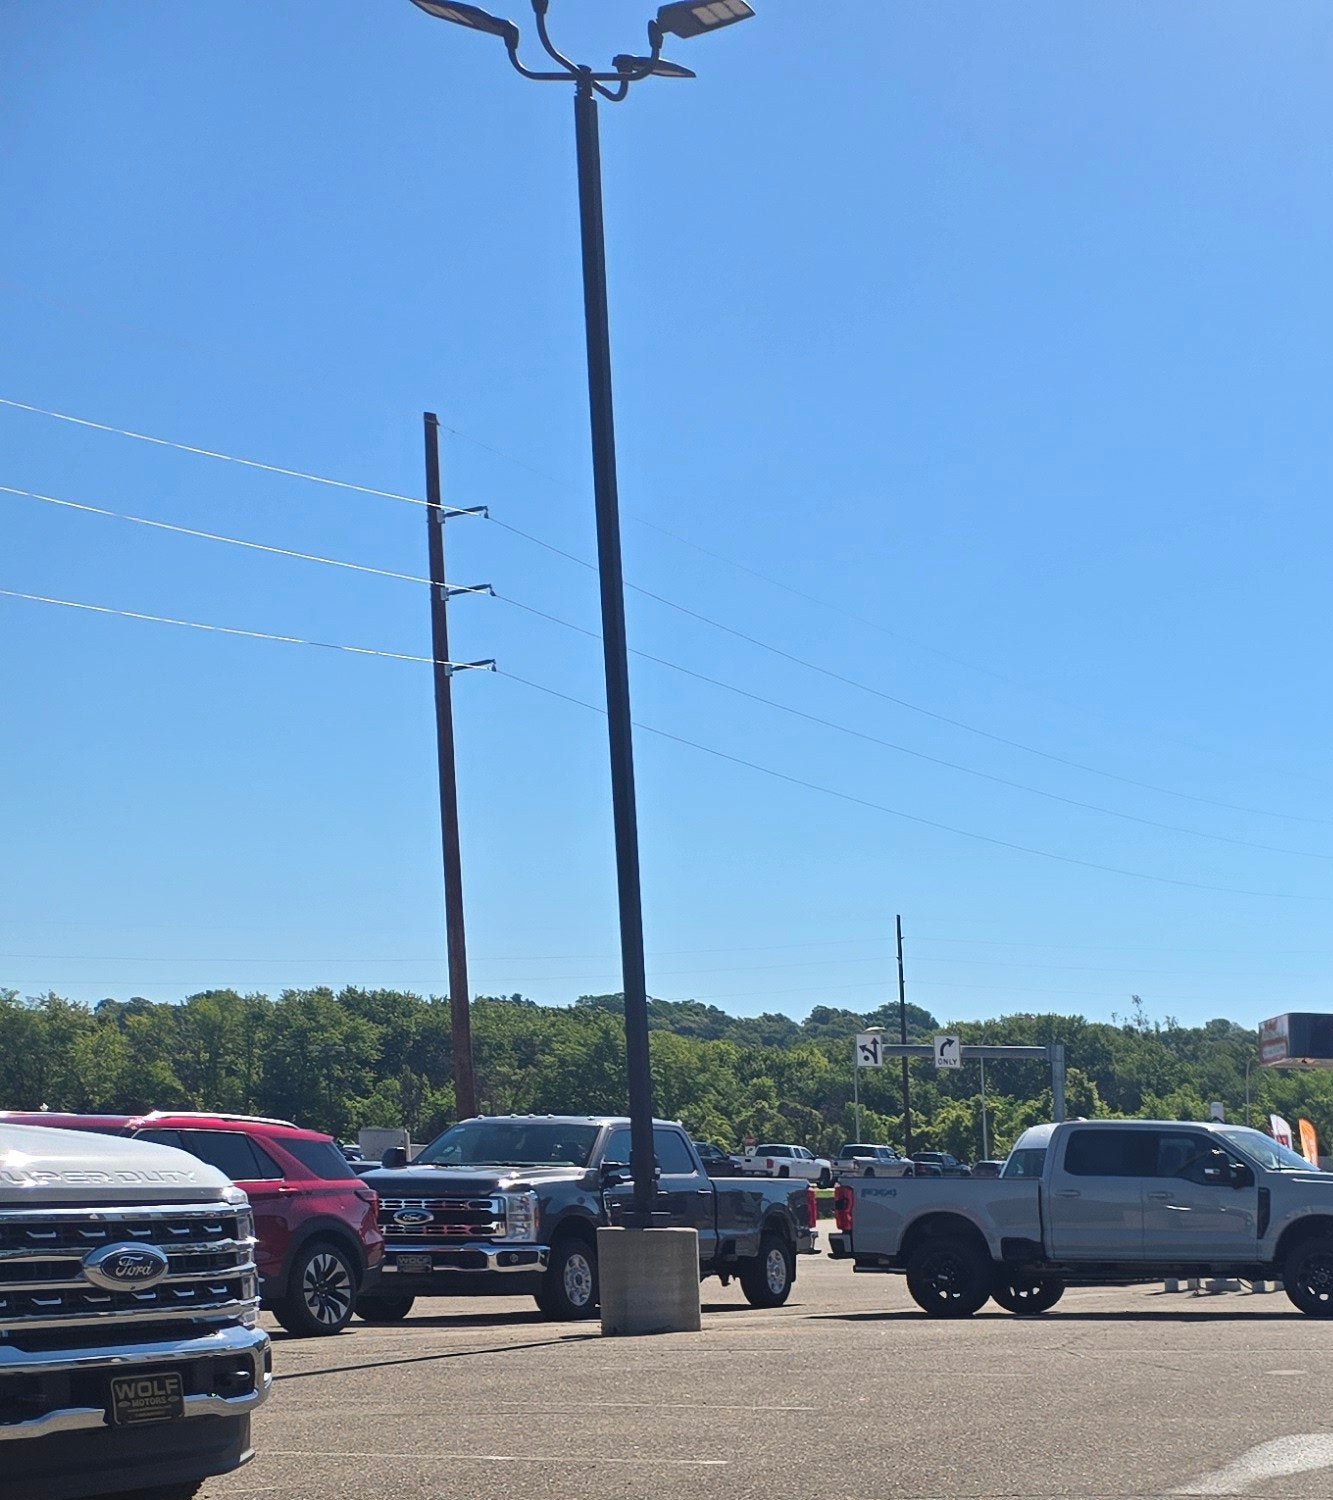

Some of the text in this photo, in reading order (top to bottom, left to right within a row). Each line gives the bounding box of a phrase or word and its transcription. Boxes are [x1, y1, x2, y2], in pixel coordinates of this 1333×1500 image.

[937, 1058, 958, 1066] ONLY
[0, 1170, 197, 1187] UPER DUTY
[115, 1256, 154, 1277] Ford
[114, 1379, 178, 1399] WOLF
[131, 1396, 167, 1407] MOTORS
